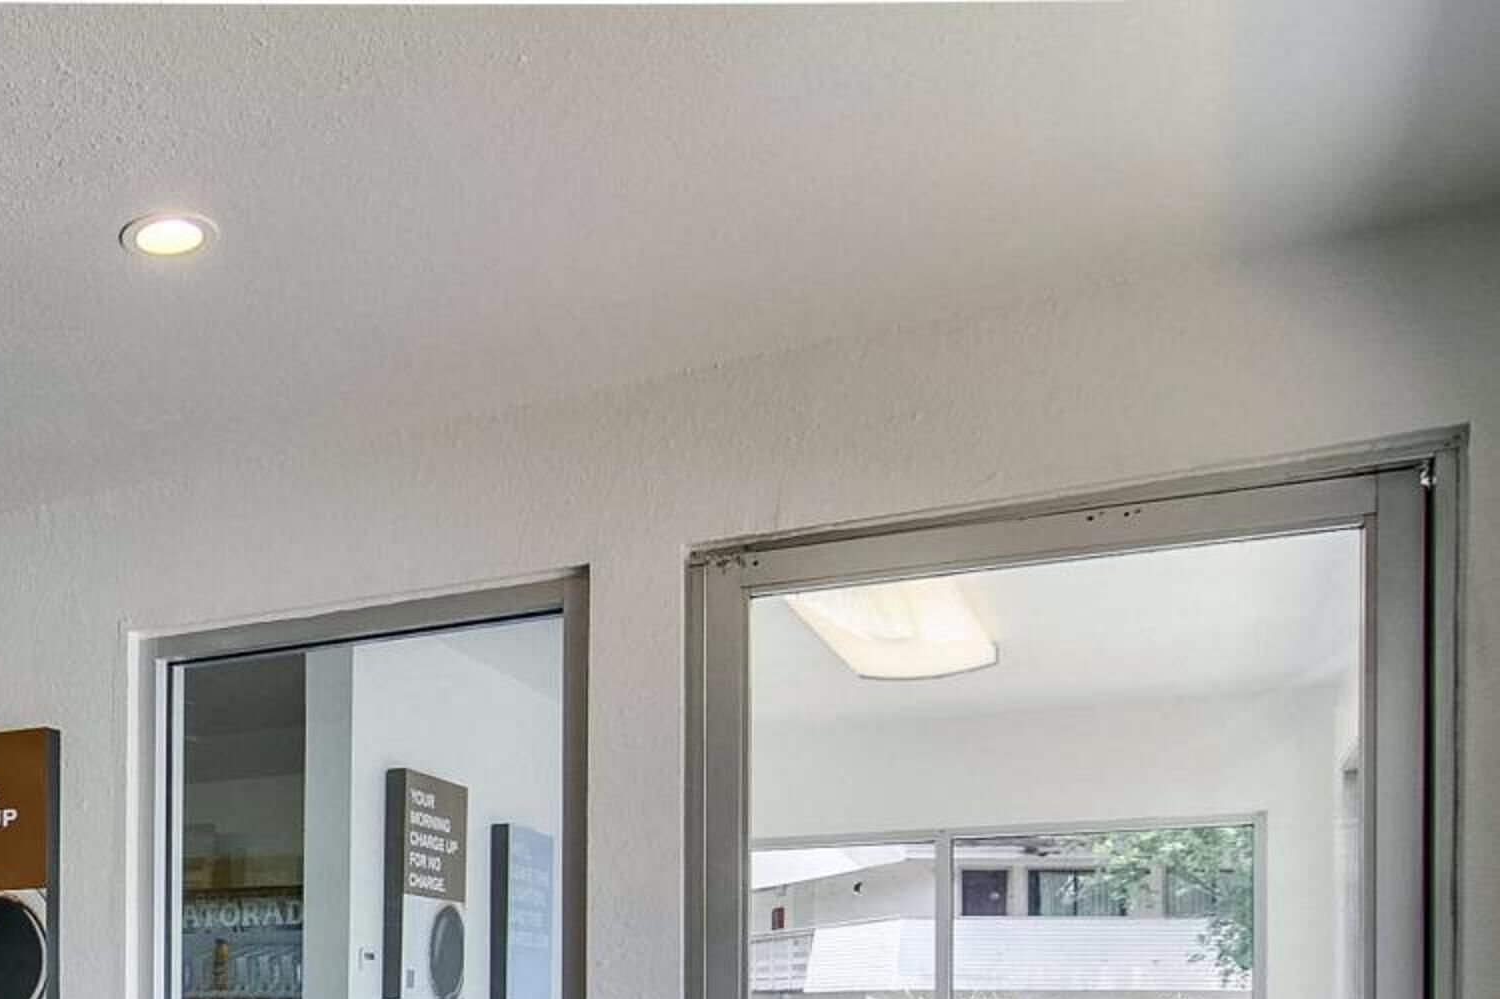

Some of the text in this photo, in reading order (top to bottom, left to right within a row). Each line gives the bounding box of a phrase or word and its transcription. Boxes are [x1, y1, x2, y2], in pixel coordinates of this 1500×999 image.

[409, 788, 435, 810] YOUR
[409, 810, 451, 833] MORNING
[409, 831, 459, 854] CHARGE UP
[409, 851, 441, 871] FOR NO
[183, 899, 301, 928] ATORAD
